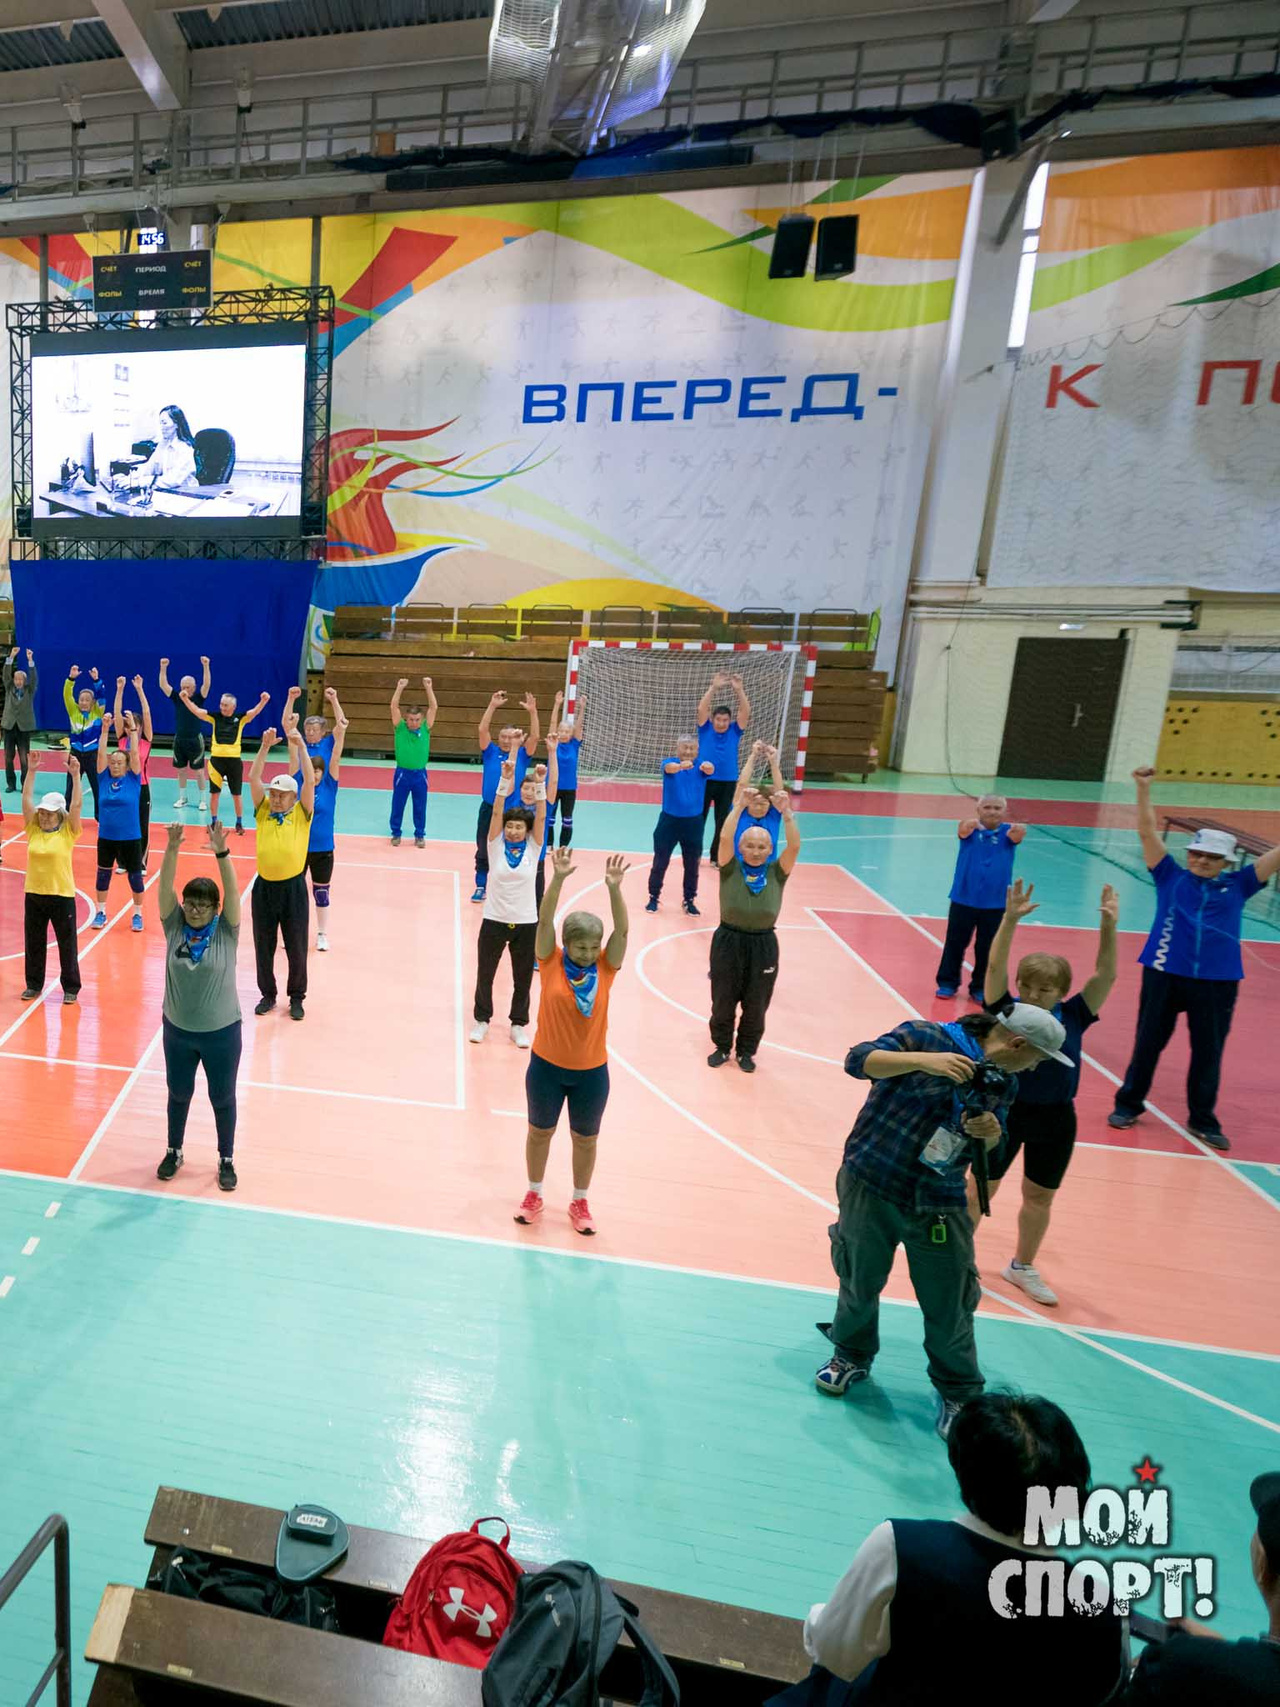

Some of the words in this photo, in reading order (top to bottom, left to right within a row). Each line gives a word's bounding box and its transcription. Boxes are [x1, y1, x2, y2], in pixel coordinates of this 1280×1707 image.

[135, 265, 167, 273] ПЕРИОД
[138, 288, 165, 297] ВРЕМЯ
[522, 373, 898, 424] ВПЕРЕД-
[1045, 363, 1104, 408] К
